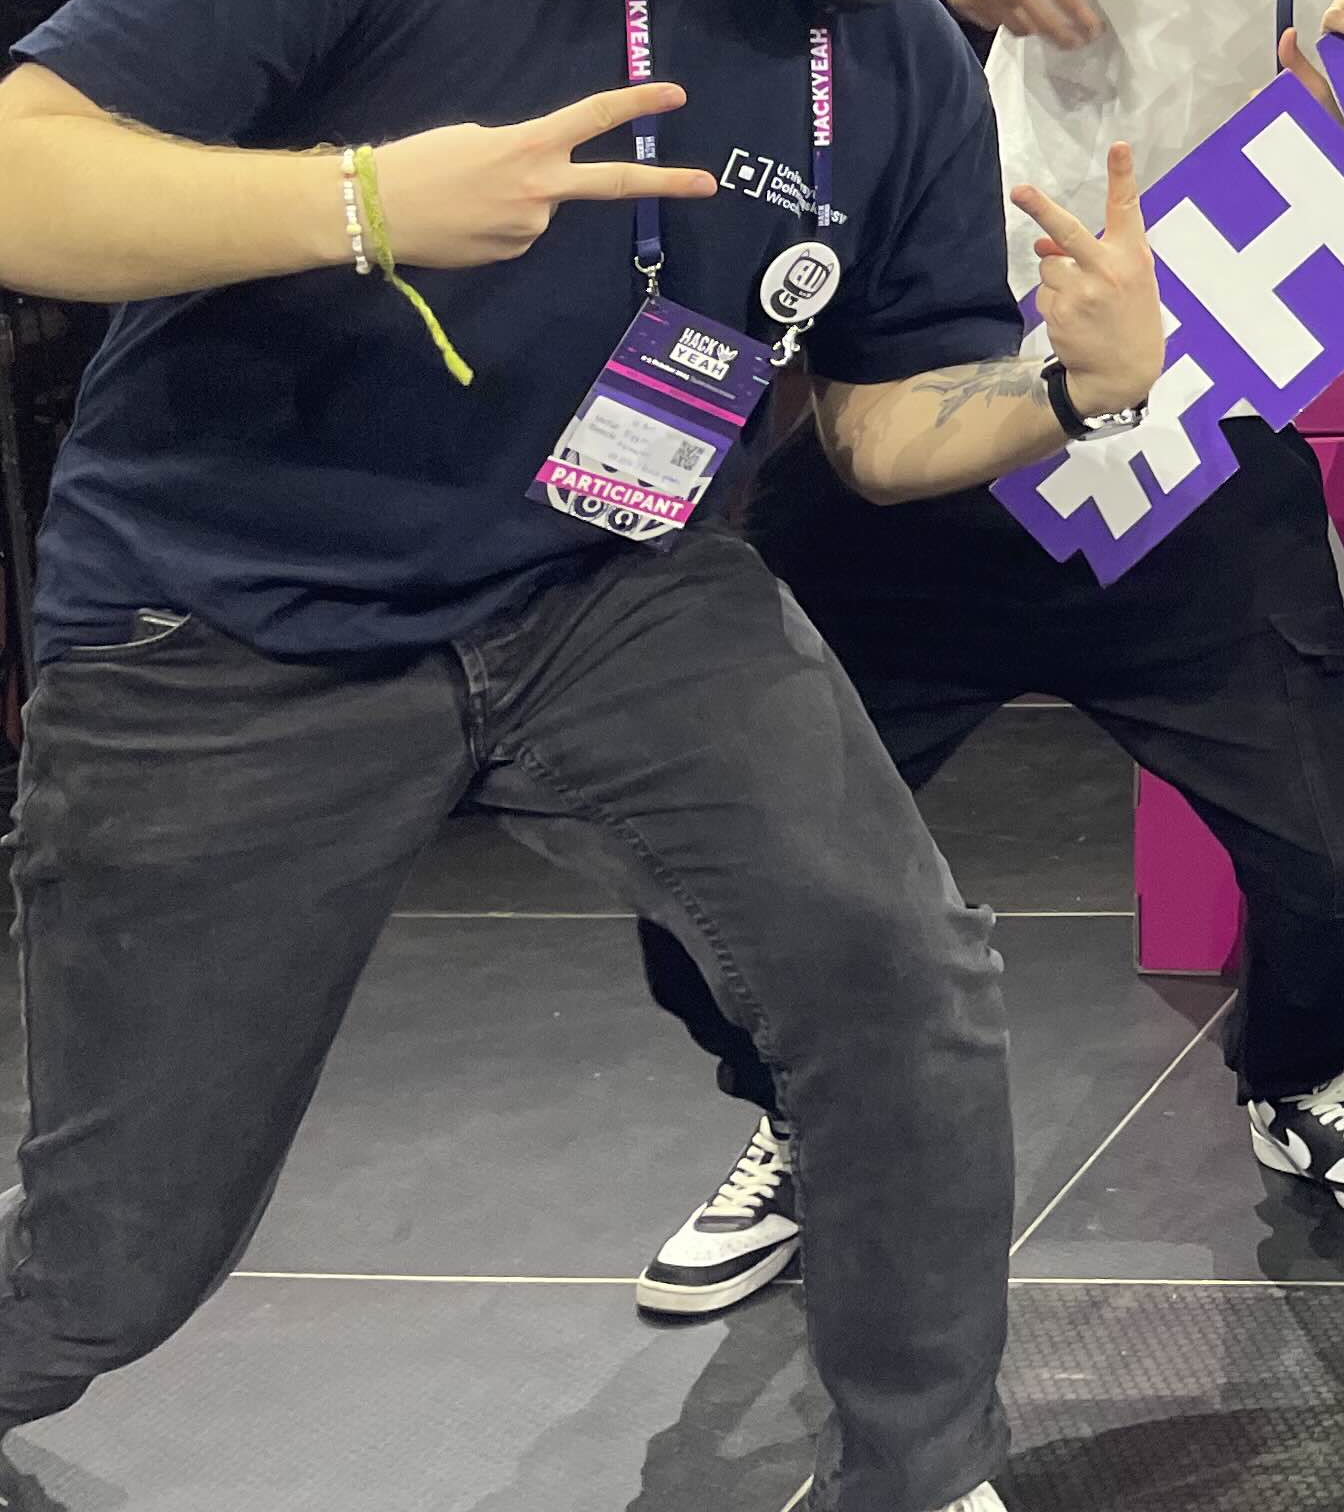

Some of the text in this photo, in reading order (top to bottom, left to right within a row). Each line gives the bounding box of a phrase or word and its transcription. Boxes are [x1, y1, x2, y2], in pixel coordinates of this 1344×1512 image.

[810, 28, 832, 148] HACKYEAH
[679, 326, 720, 356] HACK
[676, 347, 727, 378] YEAH
[550, 466, 685, 520] PARTICIPANT
